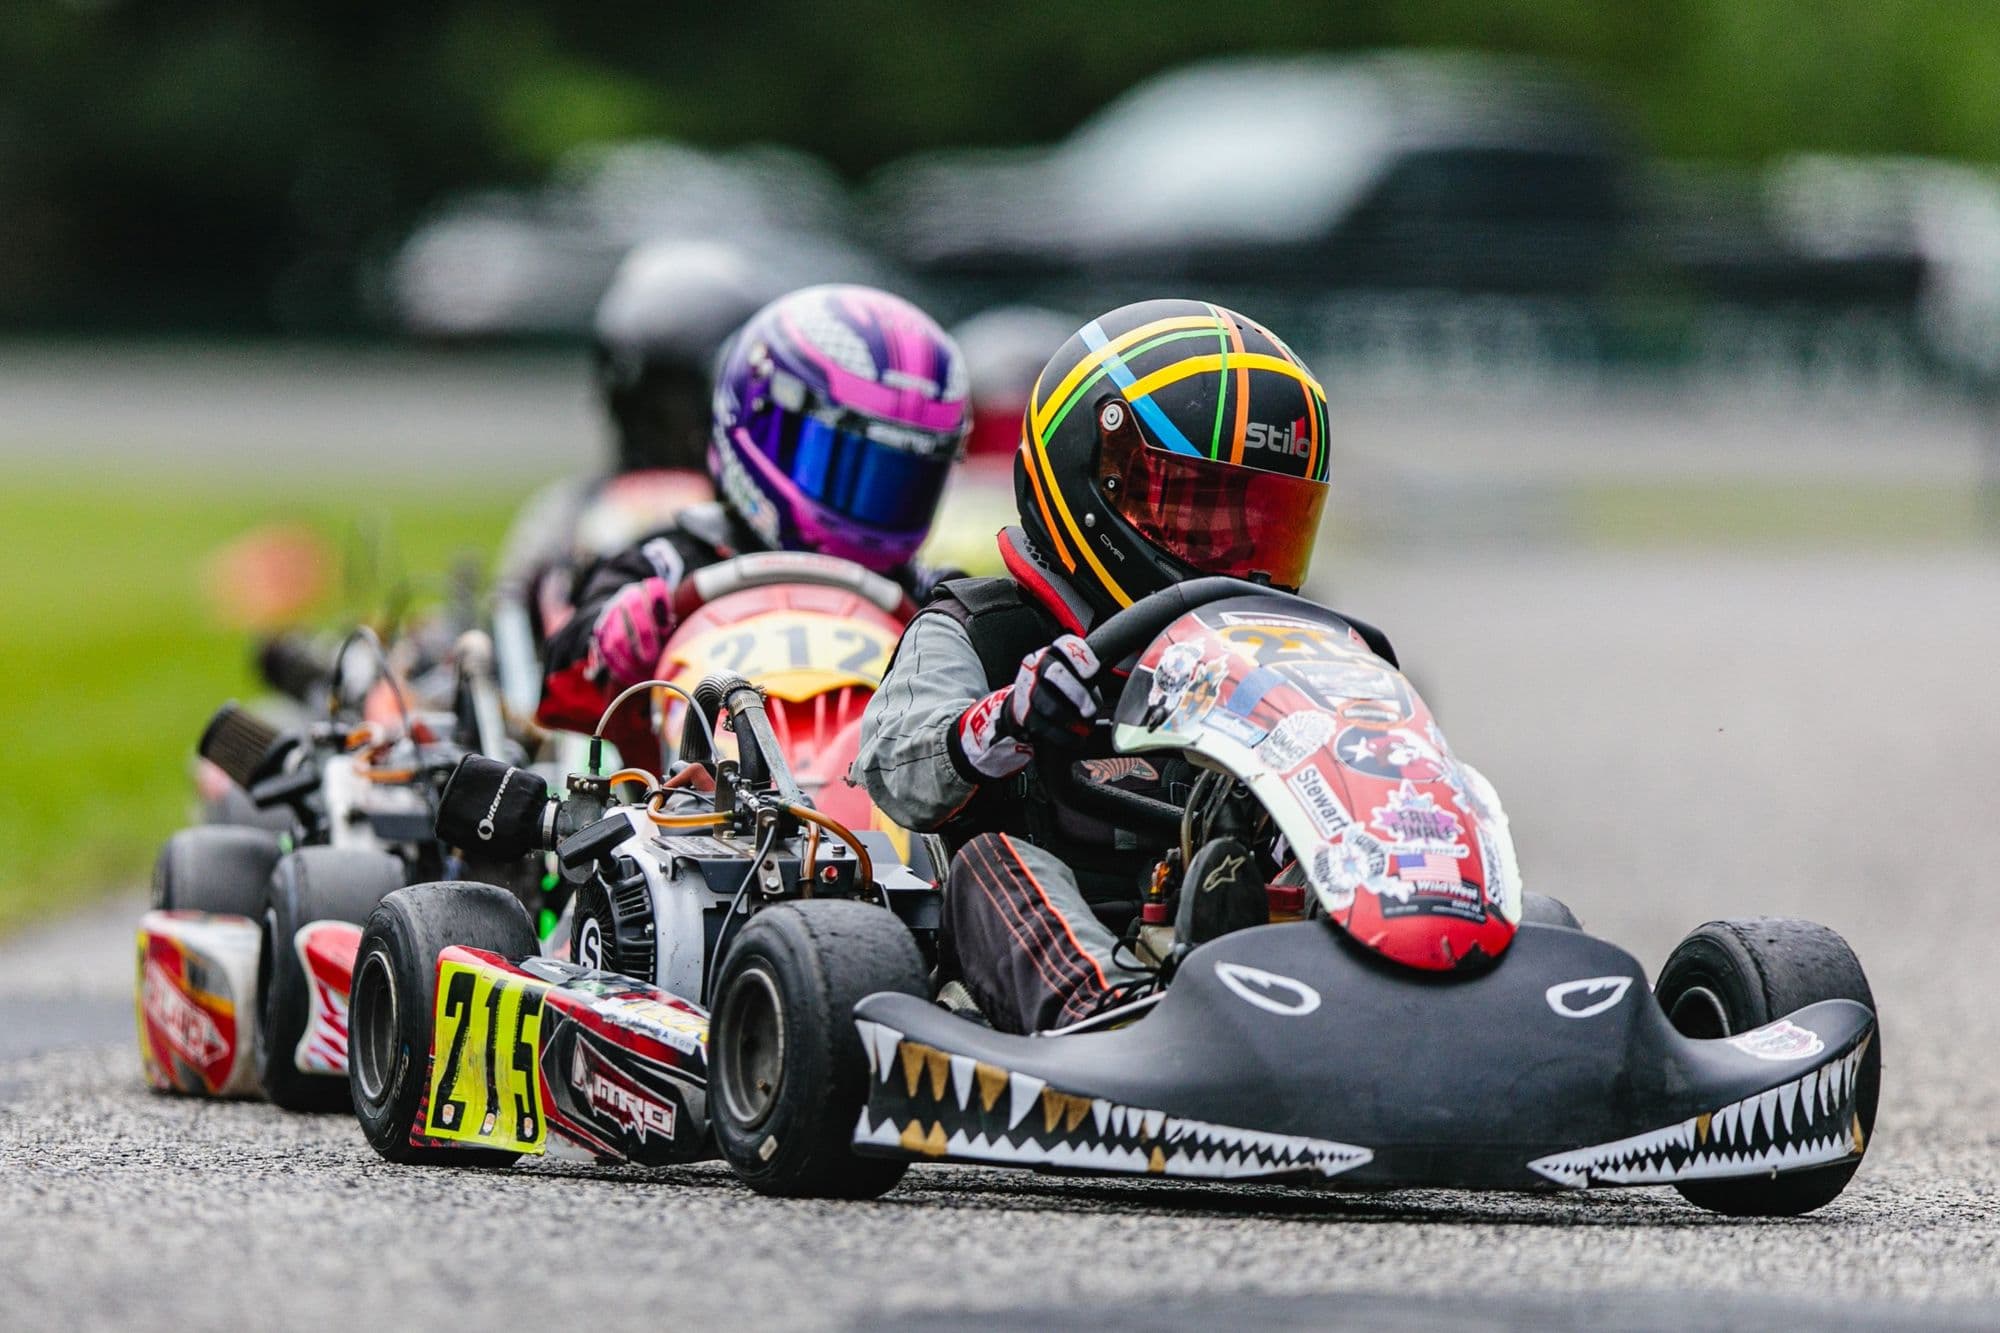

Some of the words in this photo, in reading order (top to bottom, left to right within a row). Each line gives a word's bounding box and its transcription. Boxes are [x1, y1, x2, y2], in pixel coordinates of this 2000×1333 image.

[1245, 417, 1310, 459] Stilo
[710, 624, 881, 677] 212
[1297, 766, 1350, 832] Stewart
[431, 972, 545, 1143] 215
[572, 1033, 677, 1142] NITRO
